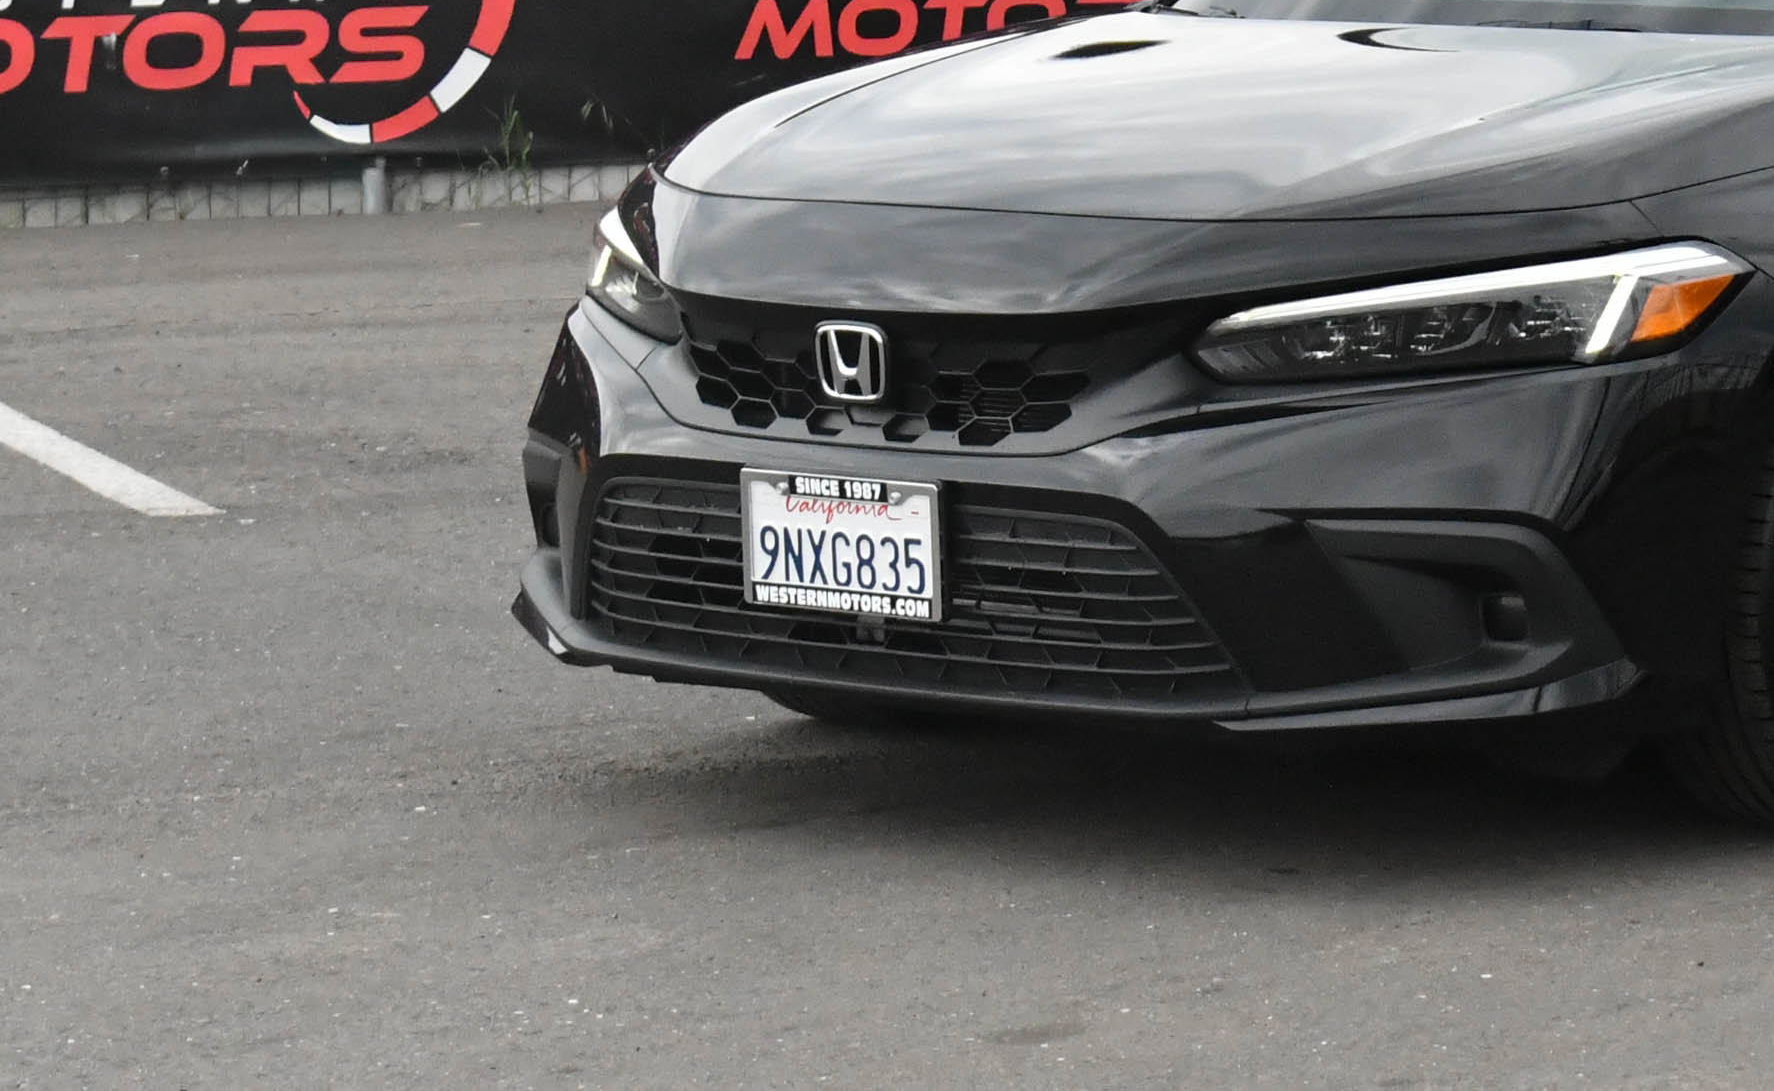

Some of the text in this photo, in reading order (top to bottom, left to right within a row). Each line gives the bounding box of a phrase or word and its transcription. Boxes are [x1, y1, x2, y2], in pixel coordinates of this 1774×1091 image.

[0, 4, 429, 94] TORS
[795, 477, 882, 500] SINCE 1987
[785, 496, 902, 524] California
[760, 525, 926, 595] 9NXG835
[755, 585, 930, 618] WESTERNMOTORS.COM
